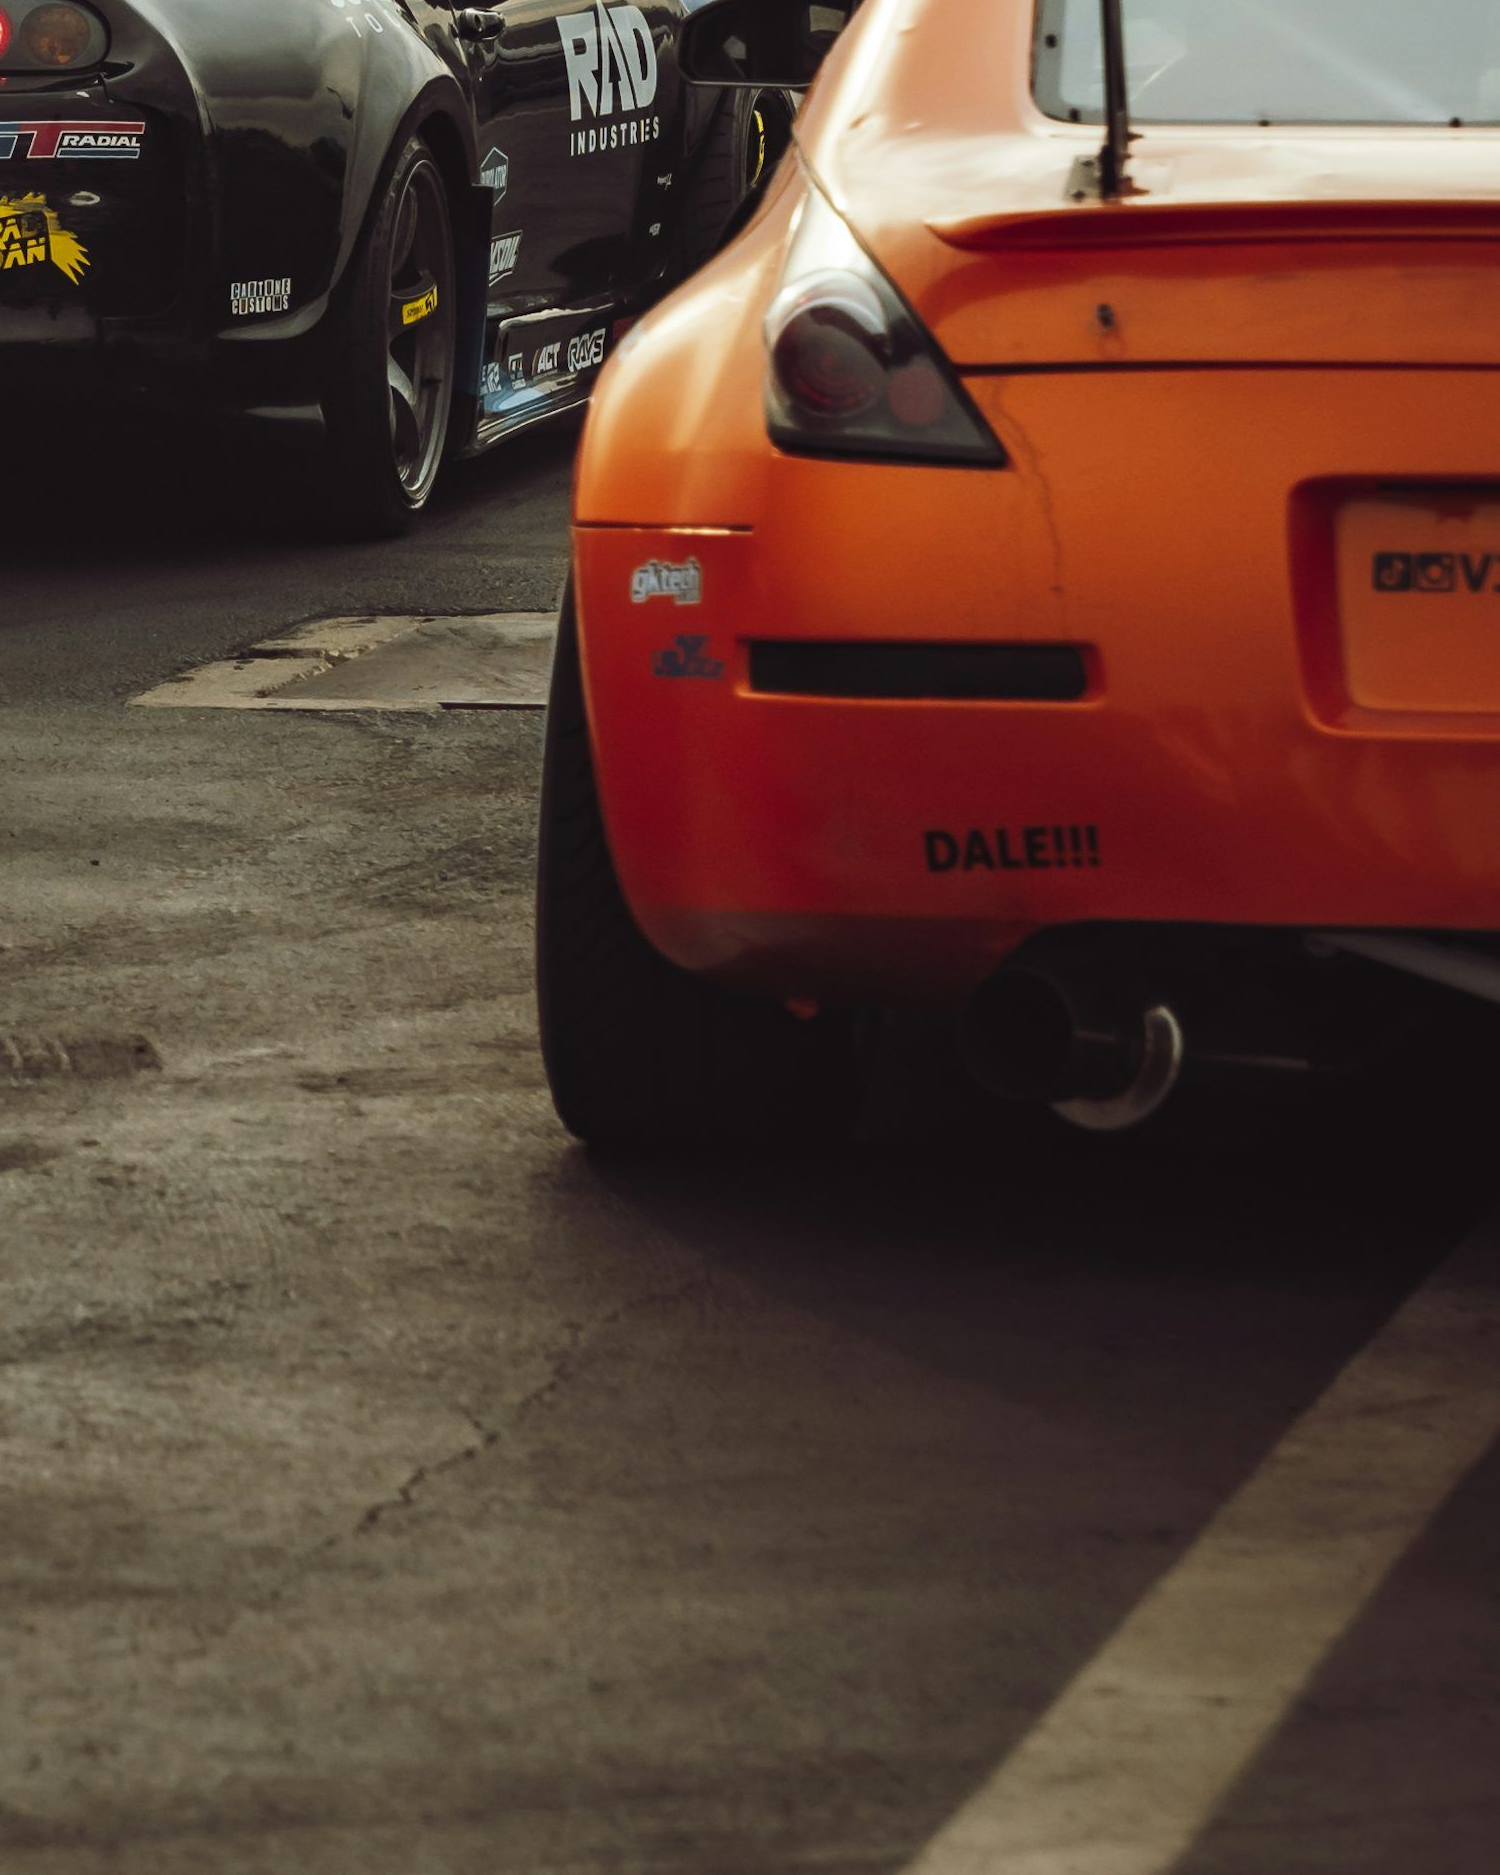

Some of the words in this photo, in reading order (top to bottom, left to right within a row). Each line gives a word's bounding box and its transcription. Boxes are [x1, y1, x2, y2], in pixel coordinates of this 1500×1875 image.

[62, 133, 142, 148] RADIAL
[569, 115, 661, 158] INDUSTRIES
[230, 278, 292, 300] CARTUNE
[231, 295, 290, 316] CUSTOMS
[923, 824, 1102, 873] DALE!!!
